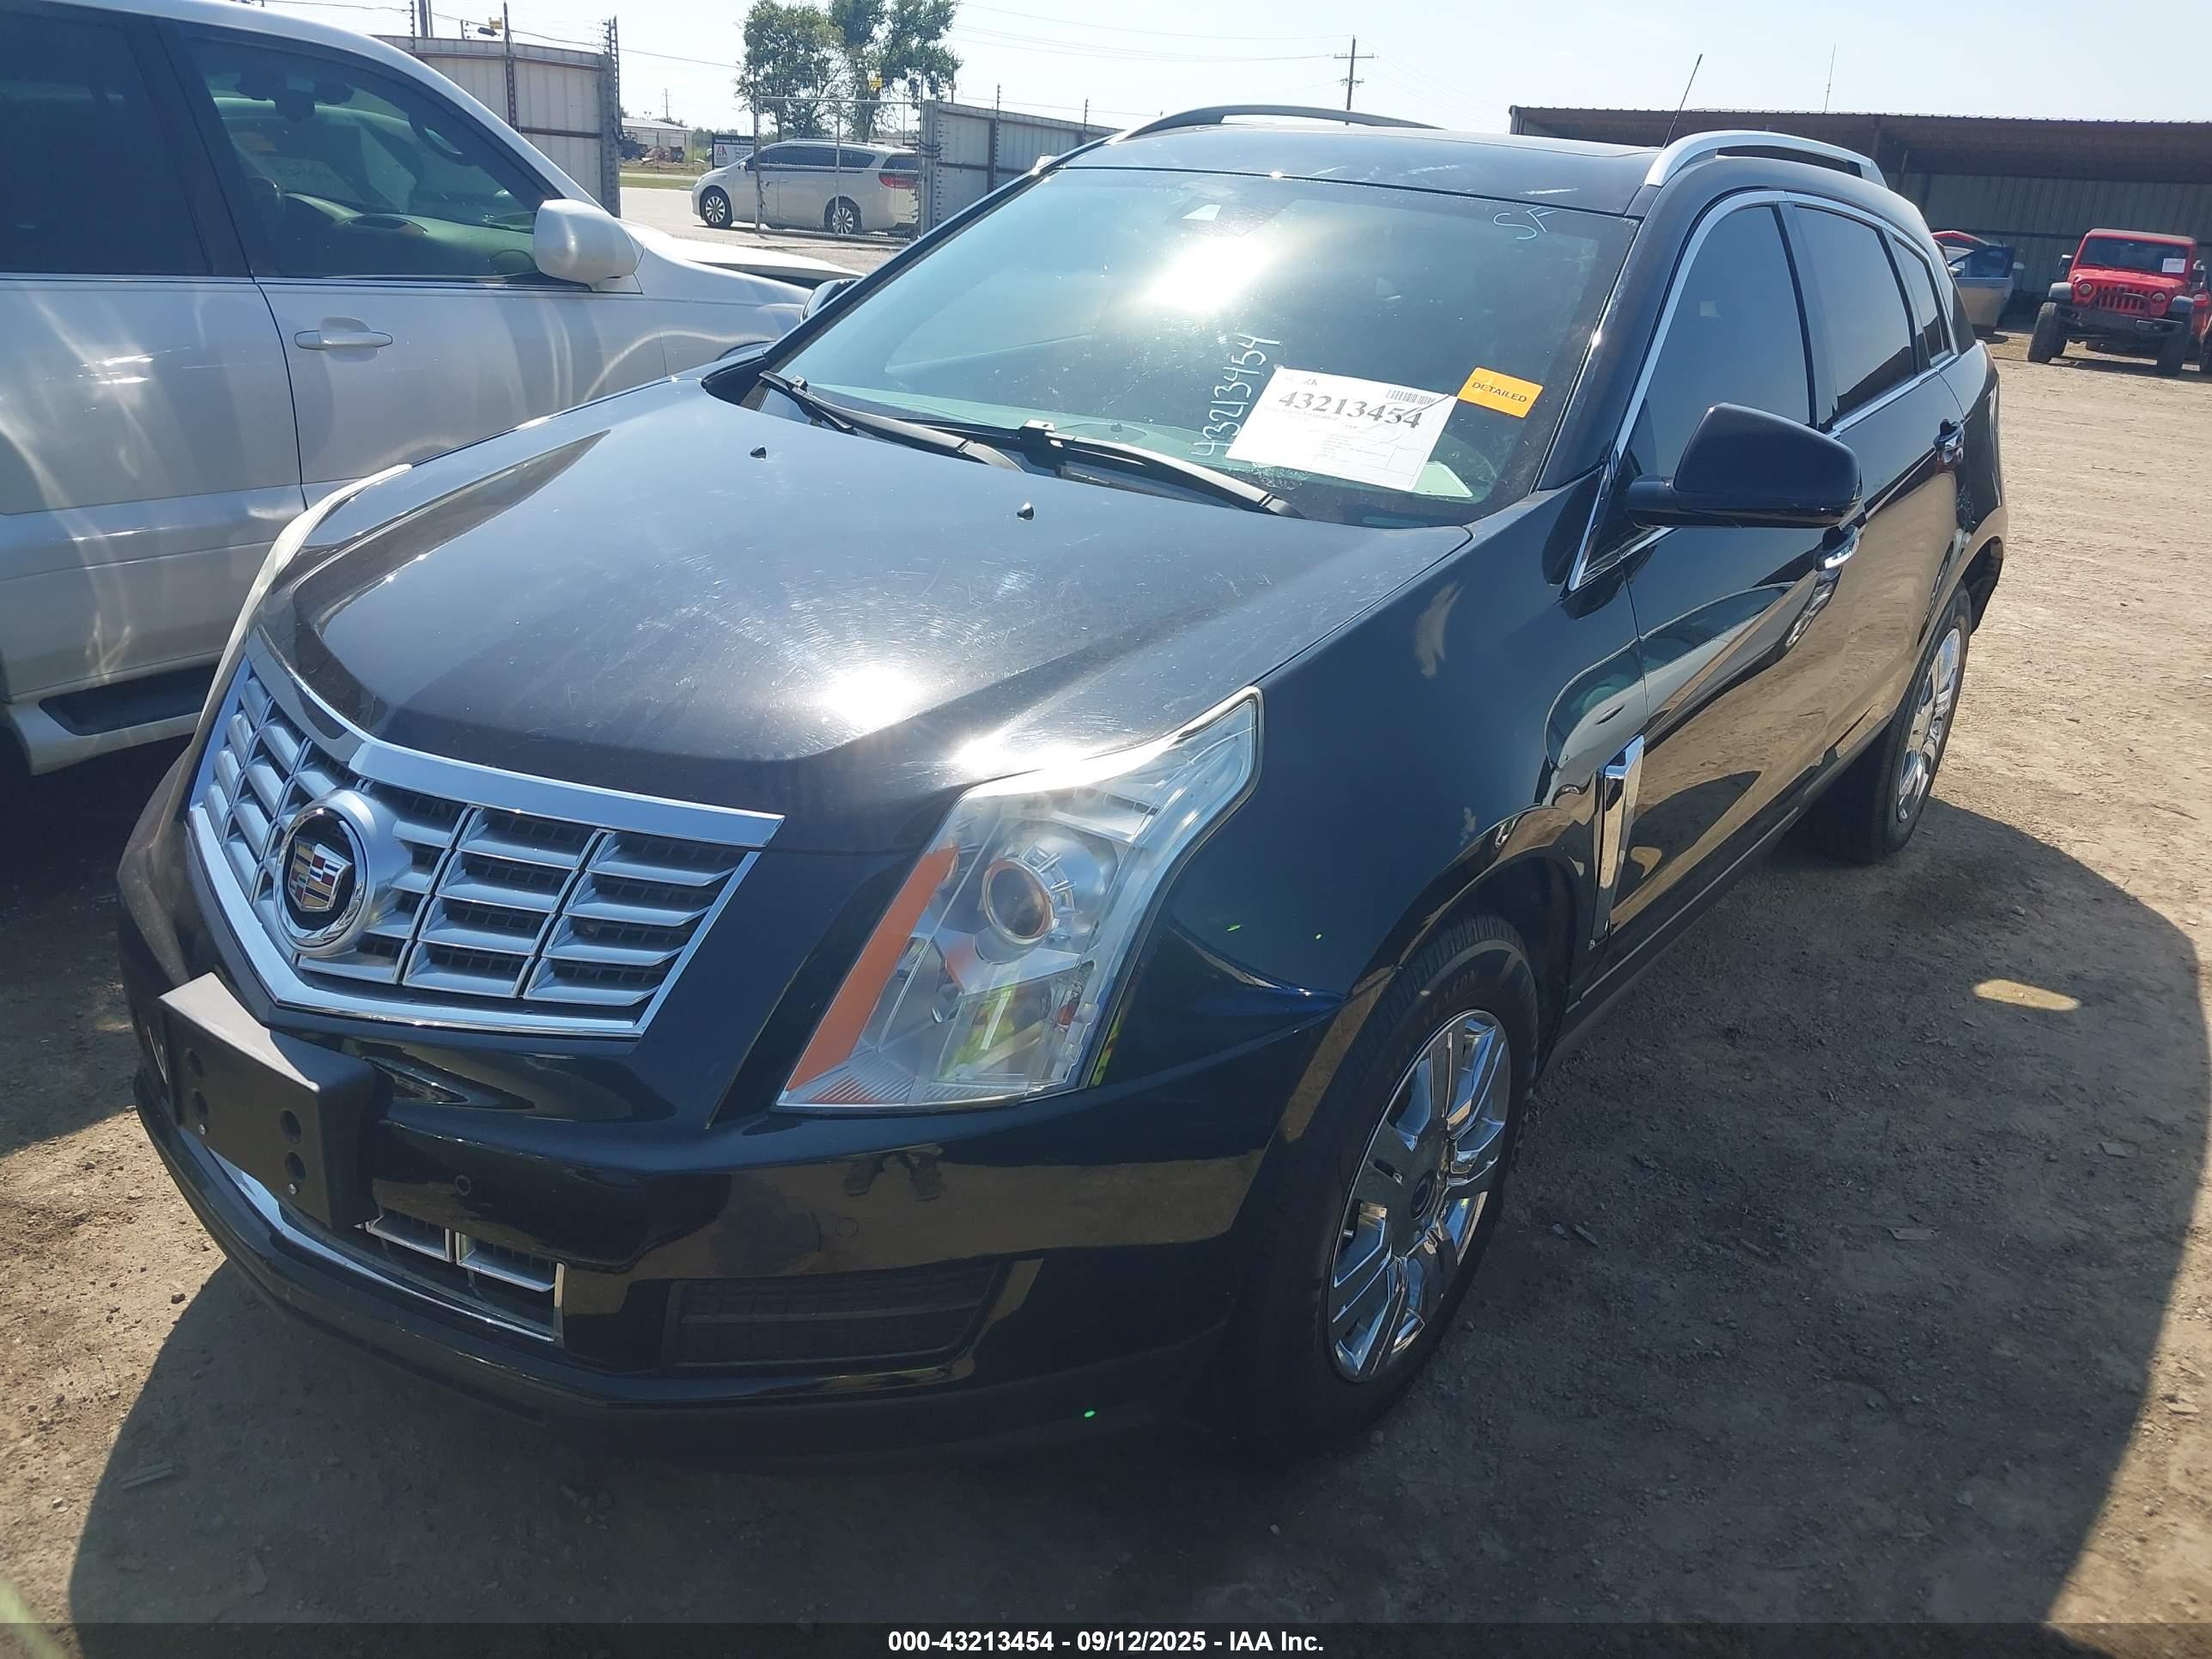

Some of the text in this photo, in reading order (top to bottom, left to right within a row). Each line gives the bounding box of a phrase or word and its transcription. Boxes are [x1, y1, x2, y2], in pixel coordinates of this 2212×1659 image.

[1190, 332, 1280, 456] 43213454
[1278, 391, 1423, 428] 43213454
[1471, 381, 1528, 404] DETAILED
